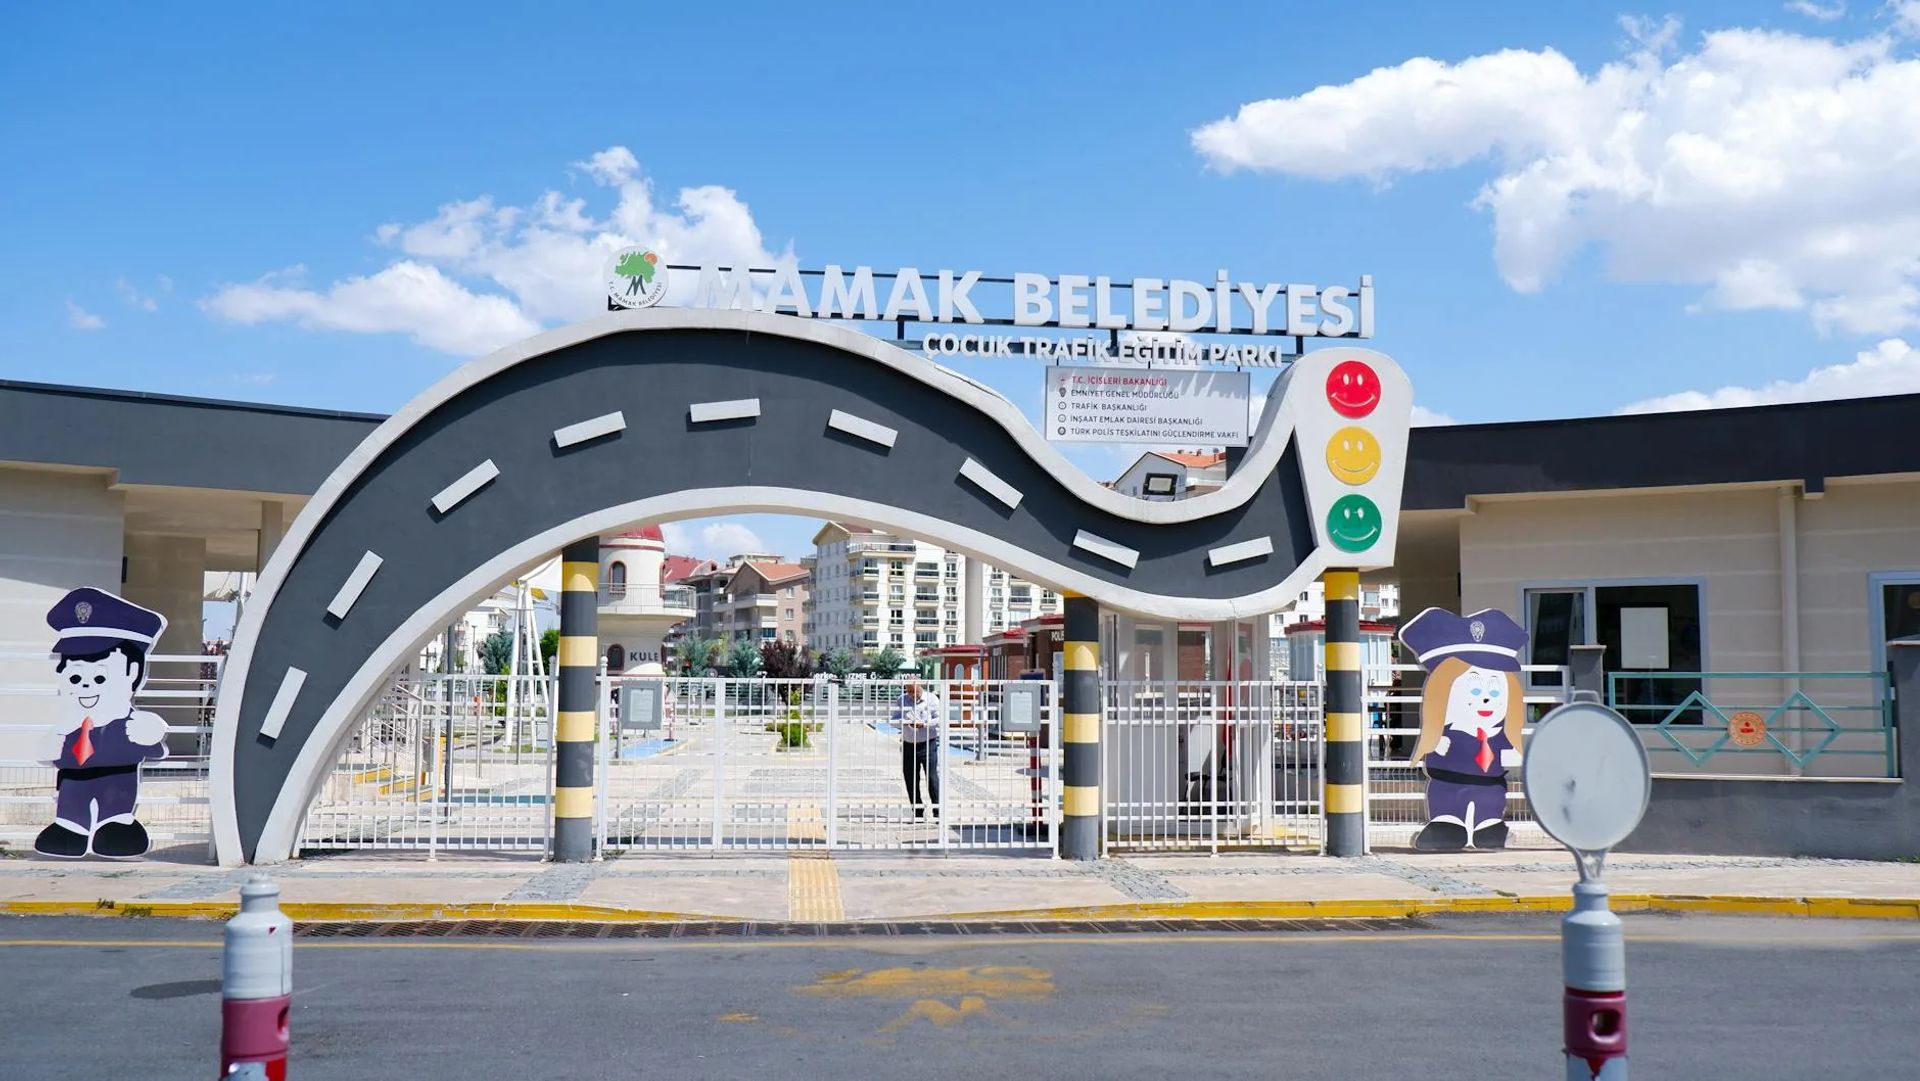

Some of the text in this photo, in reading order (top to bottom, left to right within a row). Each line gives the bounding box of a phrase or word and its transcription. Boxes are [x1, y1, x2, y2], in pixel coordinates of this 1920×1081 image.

[693, 260, 1374, 339] MAMAK BELEDİYESİ
[923, 333, 1283, 369] ÇOCUK TRAFİK EĞİTİM PARKI
[1072, 376, 1085, 385] T.C.
[1071, 389, 1105, 399] EMNİYET
[1105, 390, 1131, 399] GENEL
[1071, 402, 1148, 412] TRAFİK BAŞKANLIĞI
[1070, 415, 1099, 424] İNŞAAT
[1099, 416, 1125, 424] EMLAK
[1158, 417, 1203, 426] BAŞKANLIĞI
[1071, 427, 1091, 436] TÜRK
[1092, 427, 1114, 436] POLİS
[630, 651, 659, 662] KULE
